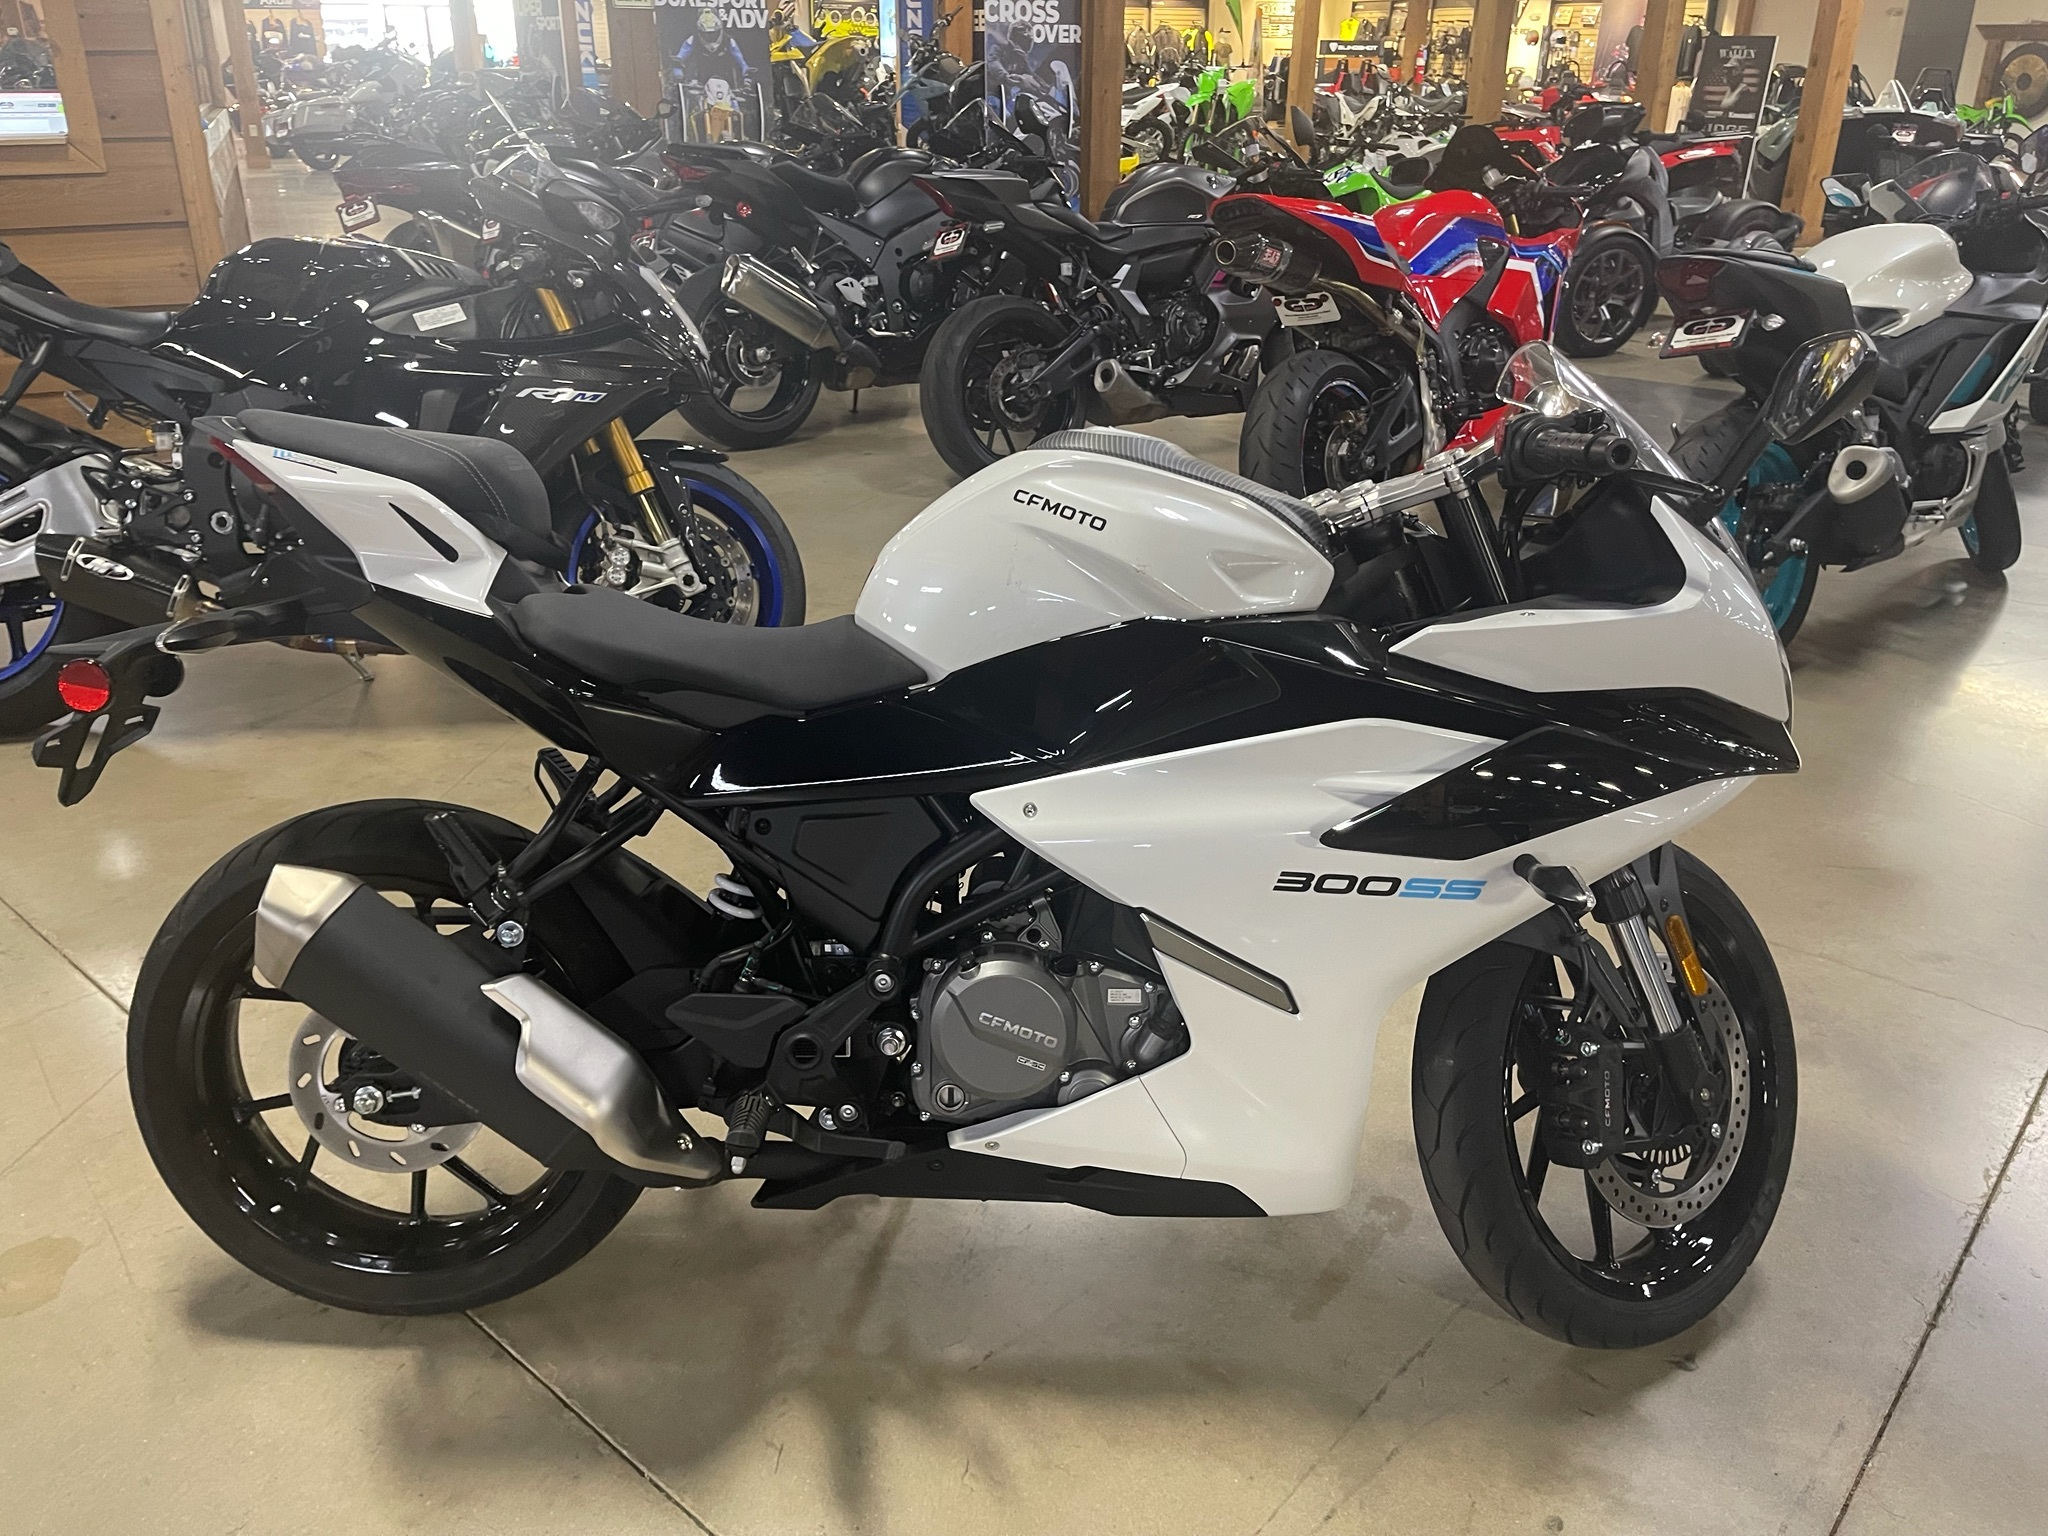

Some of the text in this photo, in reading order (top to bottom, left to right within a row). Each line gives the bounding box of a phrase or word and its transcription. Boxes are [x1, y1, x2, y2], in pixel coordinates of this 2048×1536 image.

[984, 0, 1060, 23] CROSS
[1032, 24, 1082, 43] OVER
[1013, 489, 1107, 532] CFMOTO
[1272, 870, 1488, 900] 300SS
[978, 1012, 1058, 1049] CFMOTO
[1604, 1070, 1612, 1127] CFMOTO
